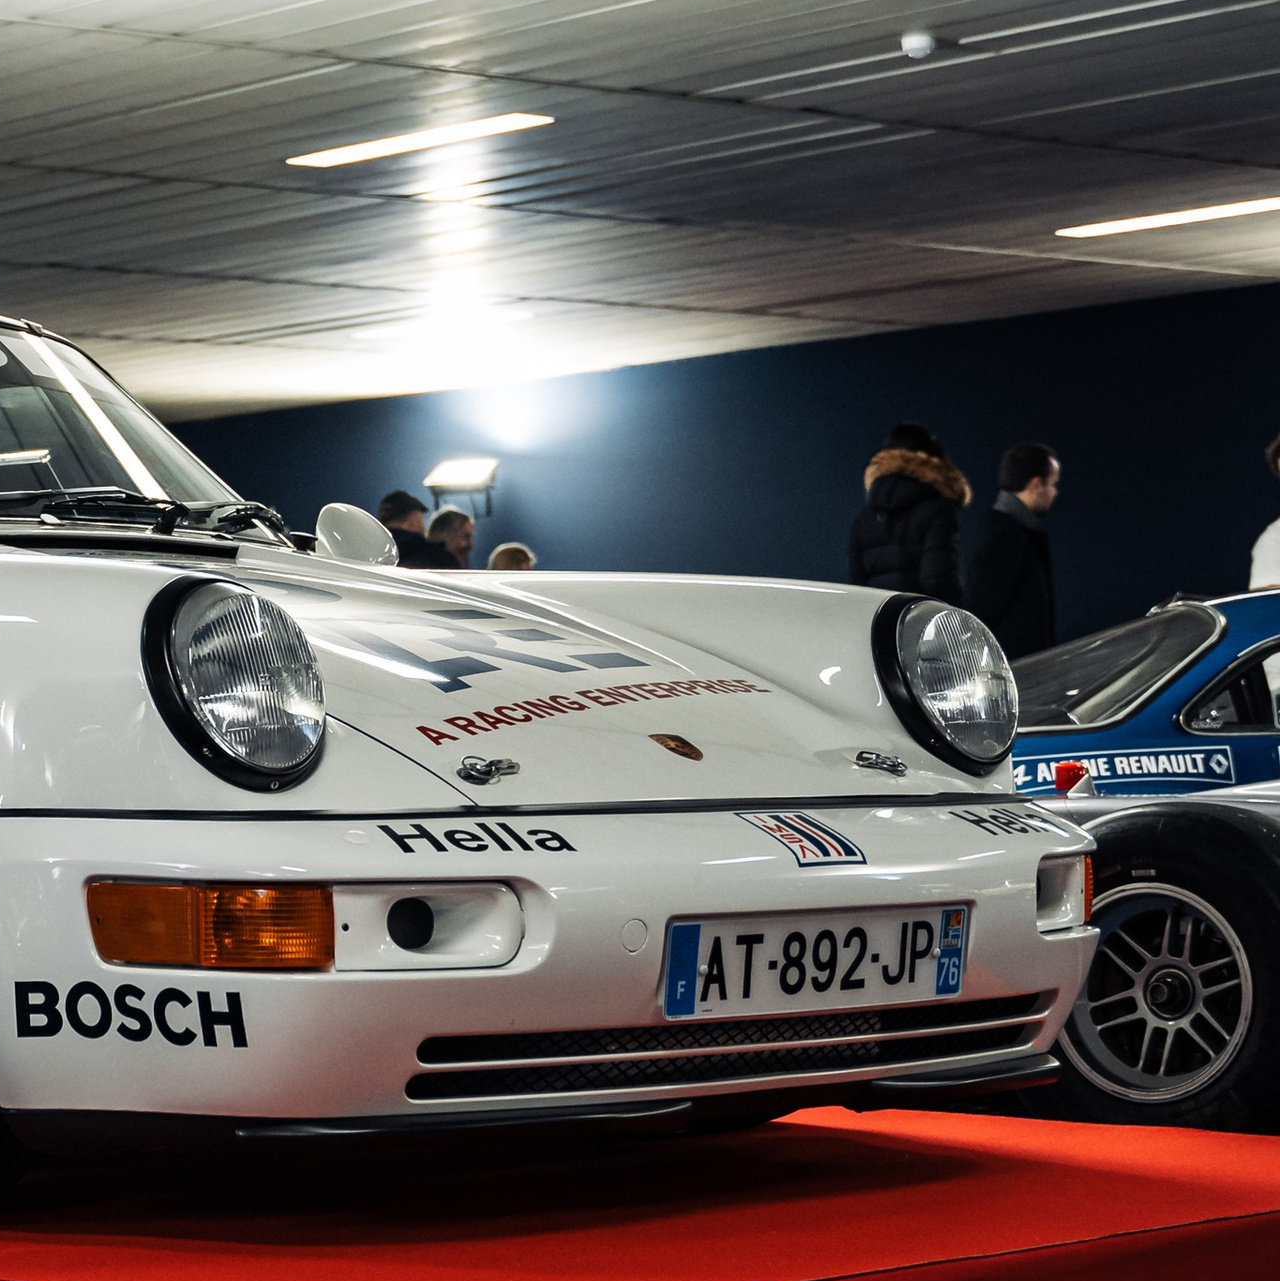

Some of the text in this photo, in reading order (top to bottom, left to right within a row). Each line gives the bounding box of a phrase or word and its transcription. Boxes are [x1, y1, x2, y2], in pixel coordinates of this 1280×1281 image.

[415, 678, 773, 746] A RACING ENTERPRISE
[1114, 753, 1207, 775] RENAULT
[377, 822, 578, 854] Hella
[753, 814, 821, 859] IMSA
[699, 920, 934, 1003] AT-892-JP
[937, 957, 960, 987] 76
[677, 980, 686, 1000] F
[14, 980, 249, 1048] BOSCH
